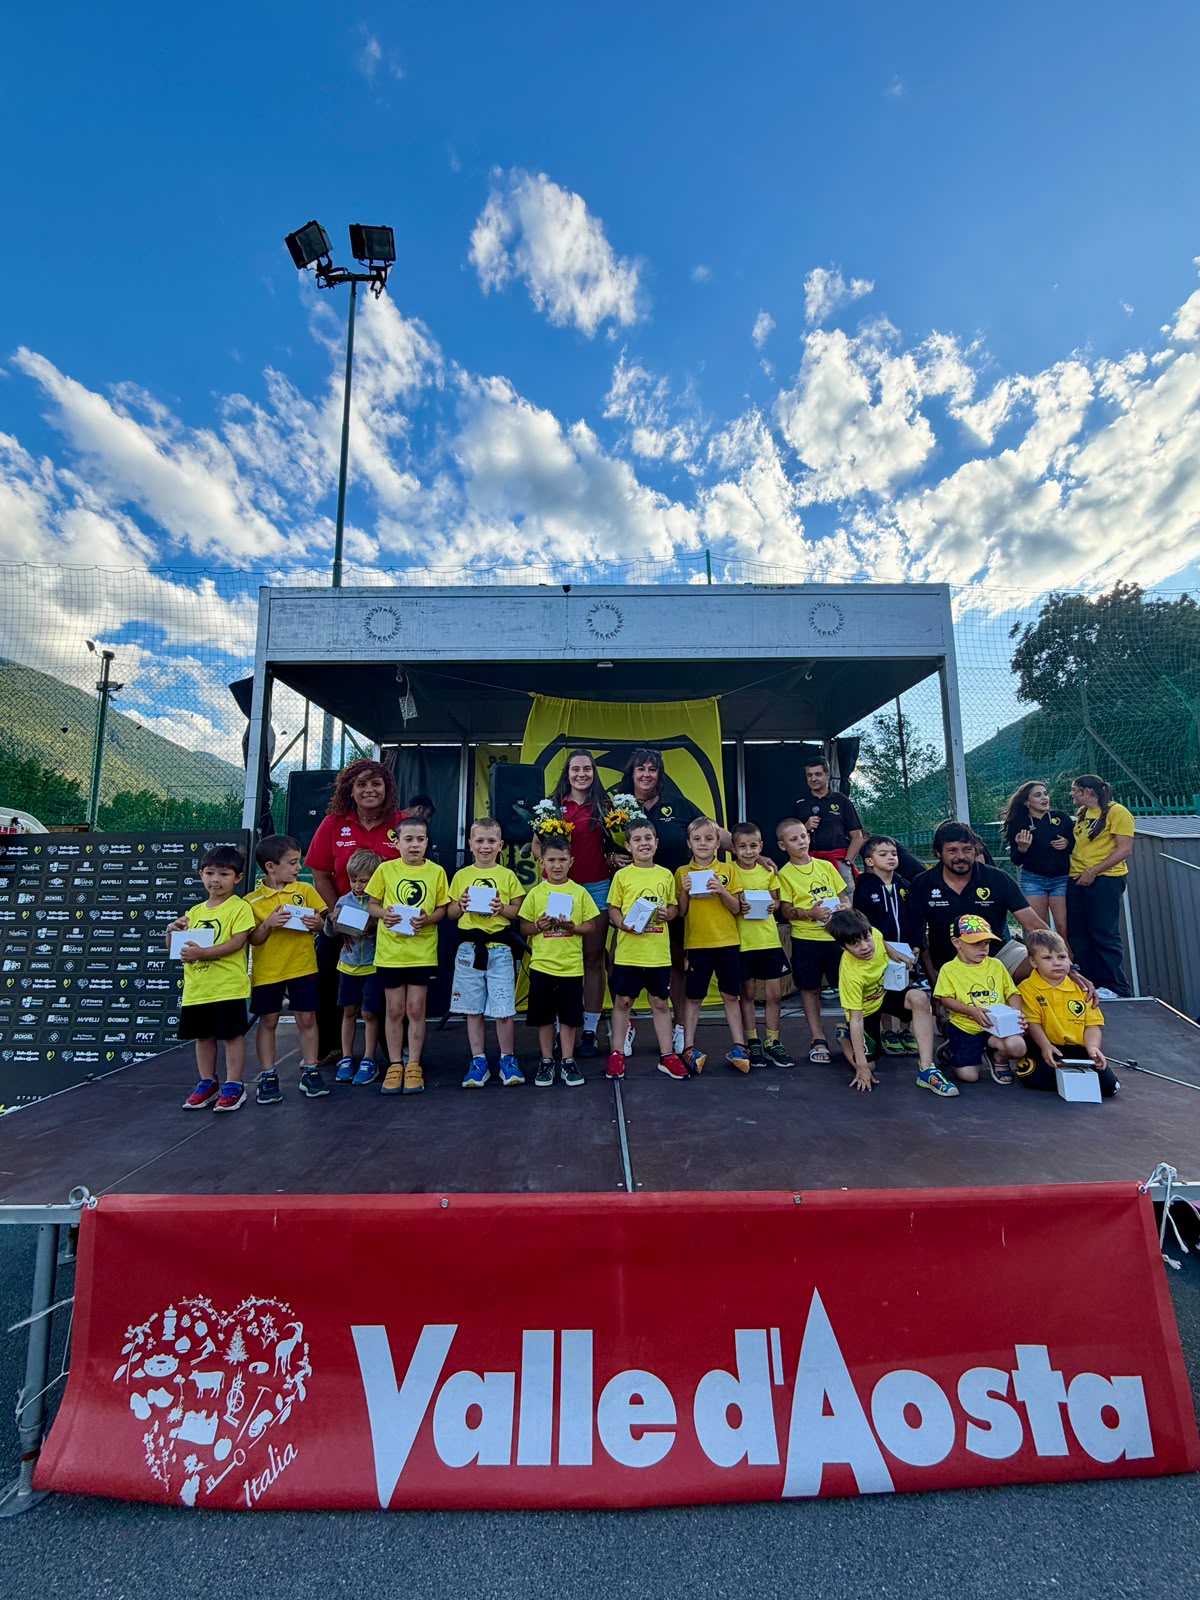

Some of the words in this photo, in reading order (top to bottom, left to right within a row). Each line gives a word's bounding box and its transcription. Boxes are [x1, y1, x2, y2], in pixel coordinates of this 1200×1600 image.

[350, 1324, 677, 1509] Valle
[693, 1286, 1155, 1498] d'Aosta
[244, 1444, 298, 1508] Italia
